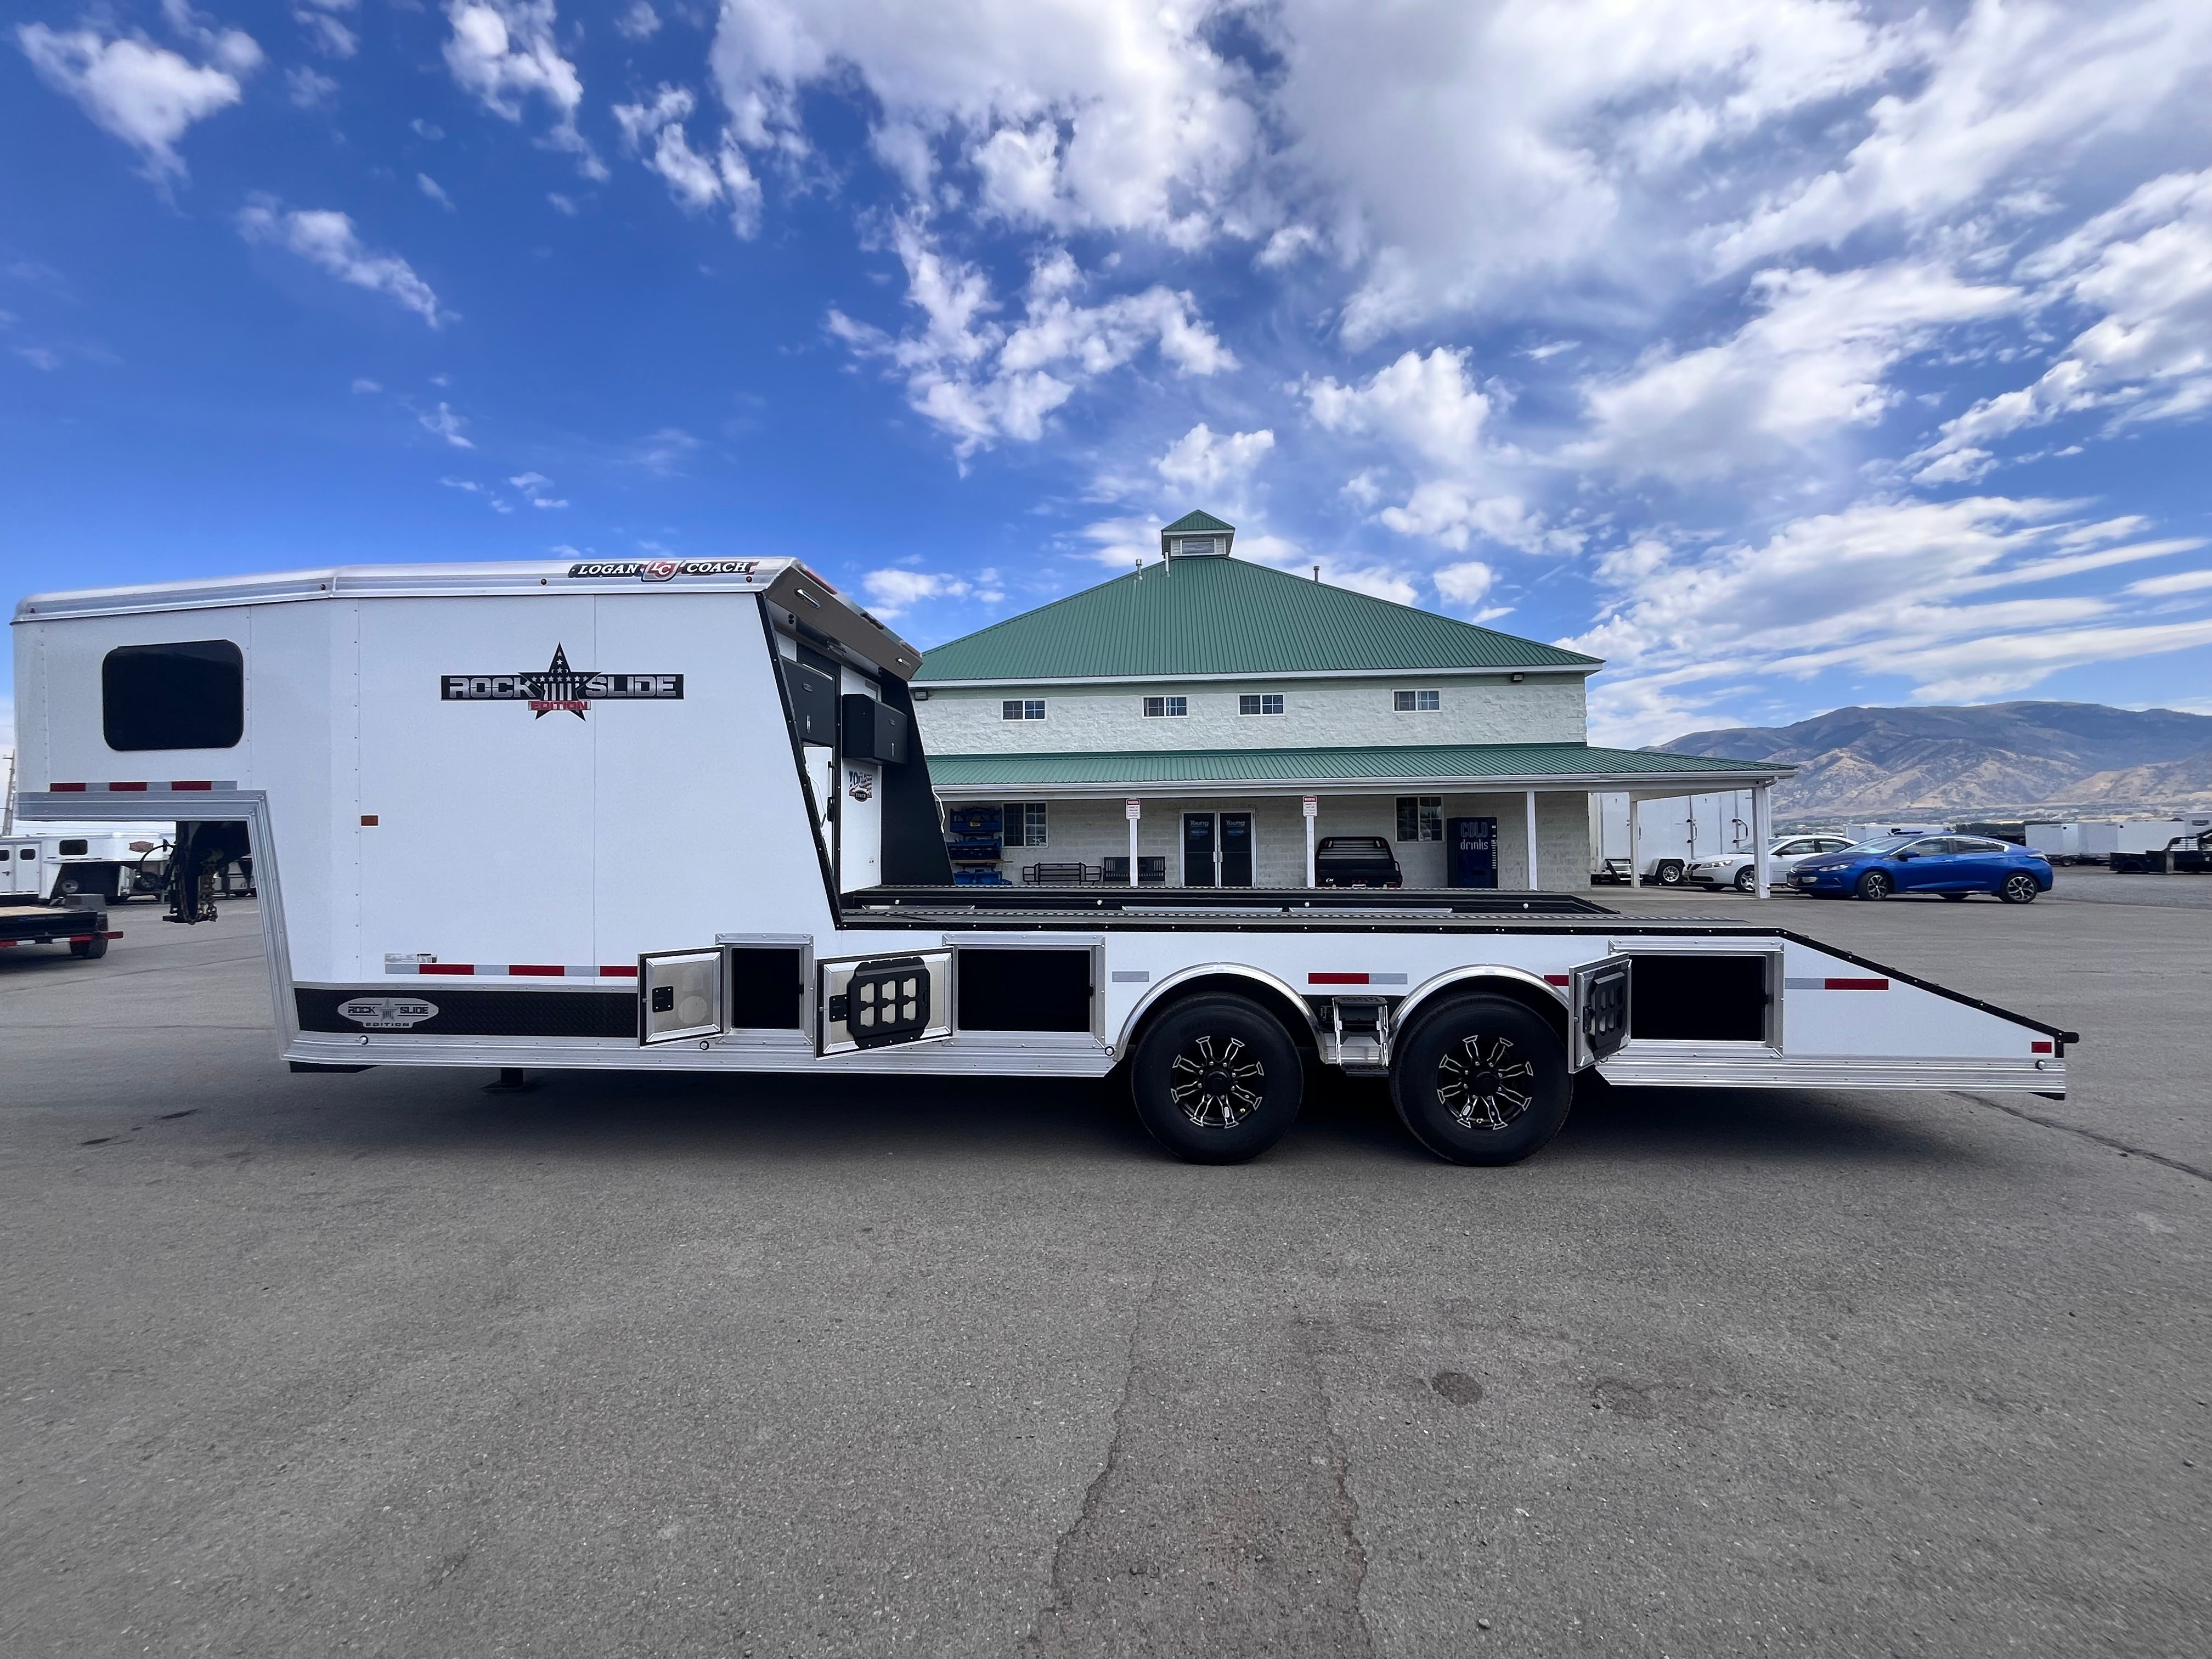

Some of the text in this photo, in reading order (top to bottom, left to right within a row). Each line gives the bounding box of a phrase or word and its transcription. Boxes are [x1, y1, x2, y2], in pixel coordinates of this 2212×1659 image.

[577, 562, 751, 575] LOGAN LC COACH
[449, 675, 676, 698] ROCK SLIDE
[531, 701, 589, 710] EDITION
[1460, 822, 1488, 838] COLD
[1460, 838, 1488, 850] drinks
[399, 1006, 429, 1014] SLIDE
